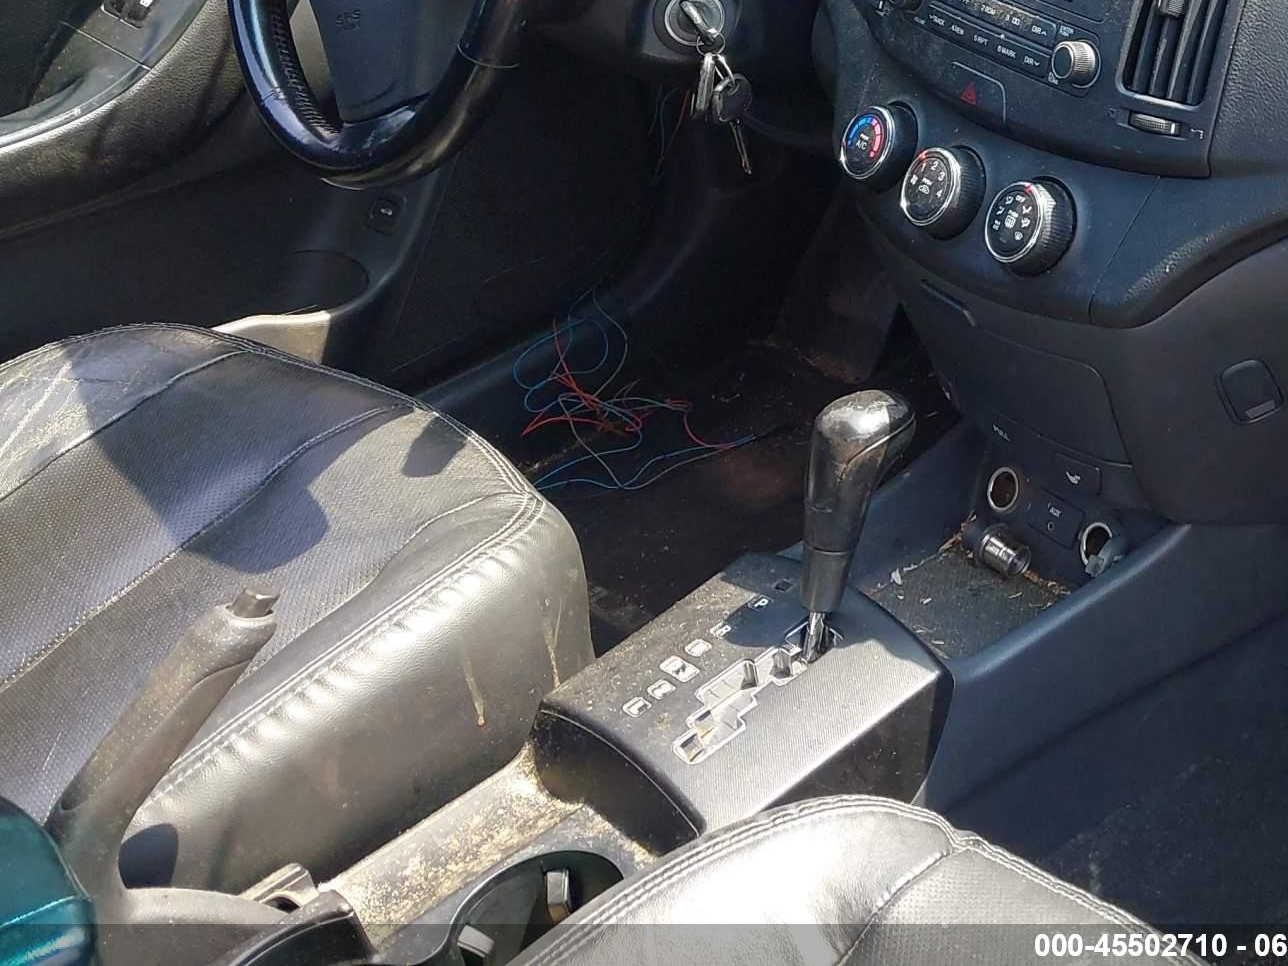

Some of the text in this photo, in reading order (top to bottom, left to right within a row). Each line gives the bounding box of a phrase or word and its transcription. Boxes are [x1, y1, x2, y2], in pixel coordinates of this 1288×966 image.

[856, 139, 868, 150] A/C
[920, 162, 927, 172] 1
[930, 160, 939, 171] 2
[937, 171, 946, 182] 3
[936, 189, 943, 199] 4
